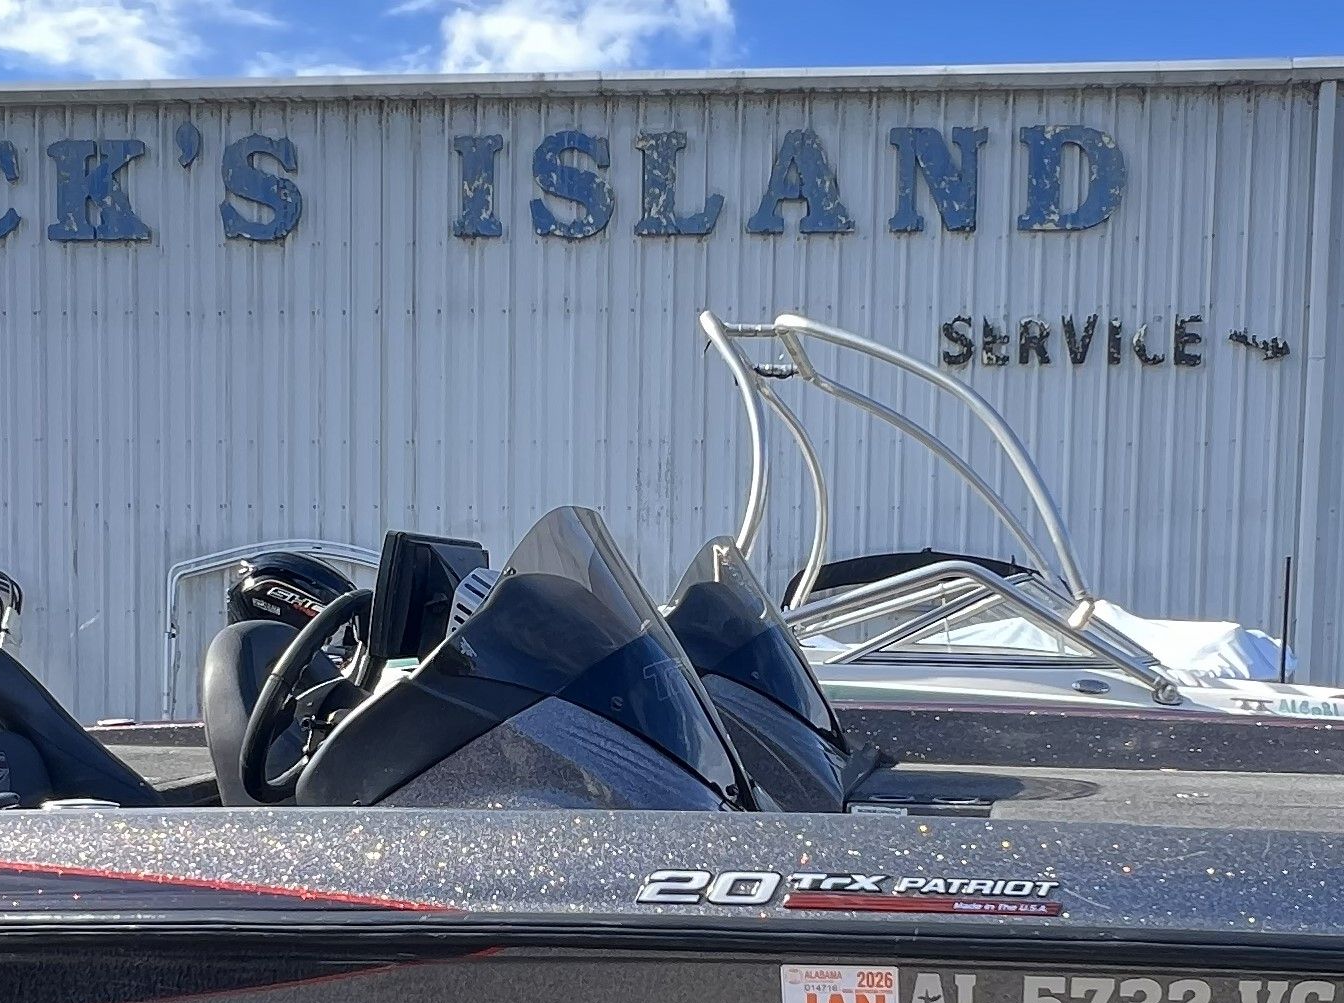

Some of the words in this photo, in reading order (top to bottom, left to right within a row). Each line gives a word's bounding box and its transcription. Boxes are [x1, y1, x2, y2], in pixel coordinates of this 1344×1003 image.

[453, 124, 1126, 238] ISLAND
[941, 313, 1203, 367] SERVICE
[635, 868, 783, 905] 20
[896, 876, 1059, 898] PATRIOT
[857, 971, 893, 989] 2026
